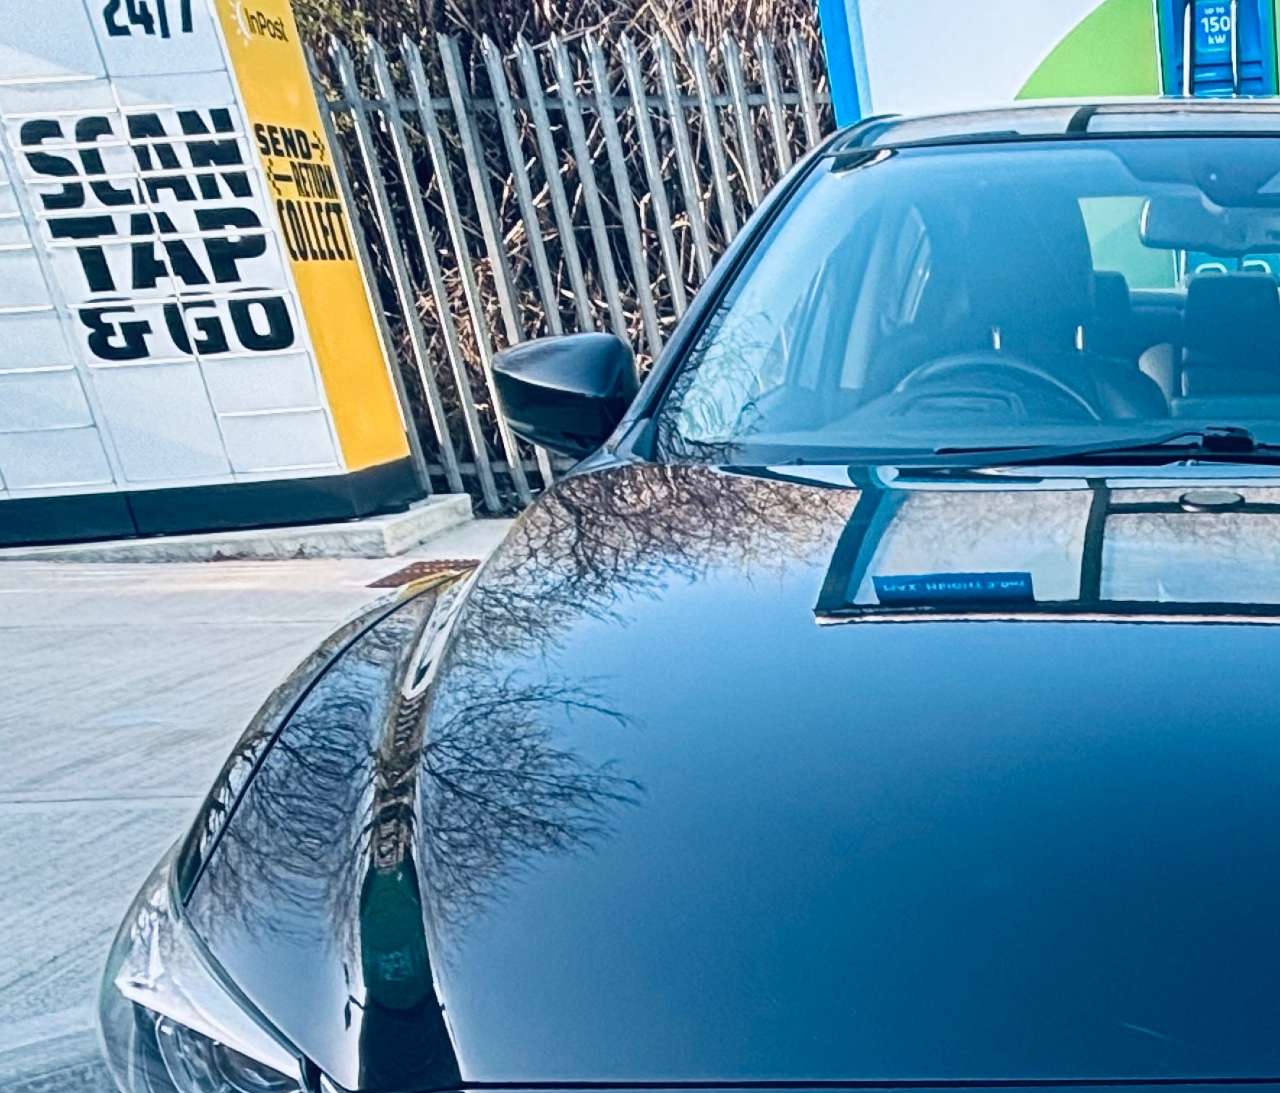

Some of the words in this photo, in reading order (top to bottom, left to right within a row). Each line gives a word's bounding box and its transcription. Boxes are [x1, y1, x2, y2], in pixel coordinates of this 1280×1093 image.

[244, 7, 289, 42] InPost
[1201, 15, 1231, 33] 150
[1208, 34, 1226, 44] kW
[19, 107, 254, 211] SCAN
[253, 122, 313, 160] SEND
[289, 160, 340, 200] RETURN
[47, 206, 267, 292] TAP
[276, 198, 354, 262] COLLECT
[79, 297, 153, 361] &
[163, 287, 295, 355] GO
